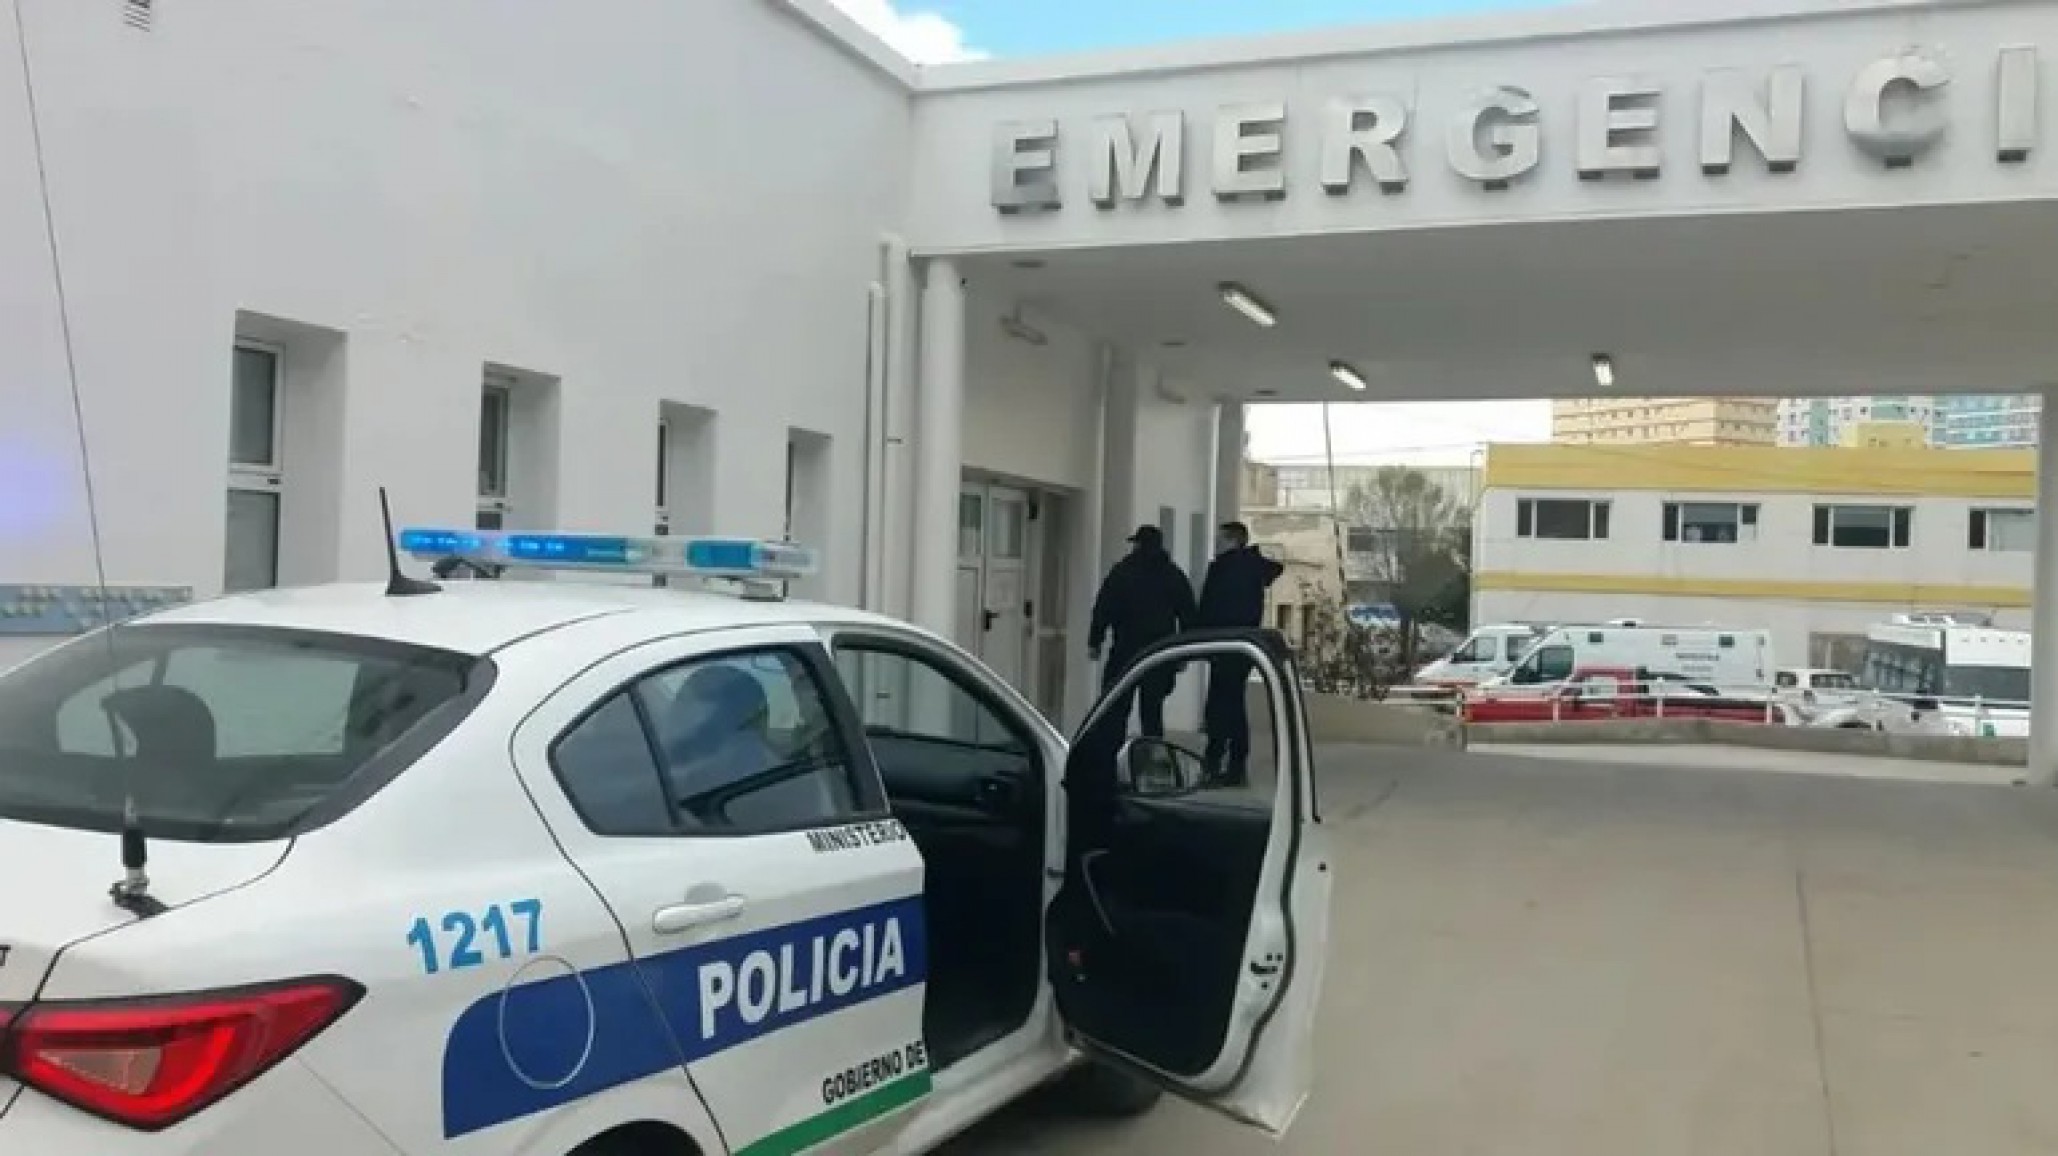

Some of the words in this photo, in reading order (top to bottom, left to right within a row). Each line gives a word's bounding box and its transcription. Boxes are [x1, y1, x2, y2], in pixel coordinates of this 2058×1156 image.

[991, 45, 2037, 214] EMERGENCI
[406, 898, 542, 974] 1217
[698, 915, 906, 1040] POLICIA
[822, 1049, 902, 1105] GOBIERNO
[905, 1040, 926, 1069] DE
